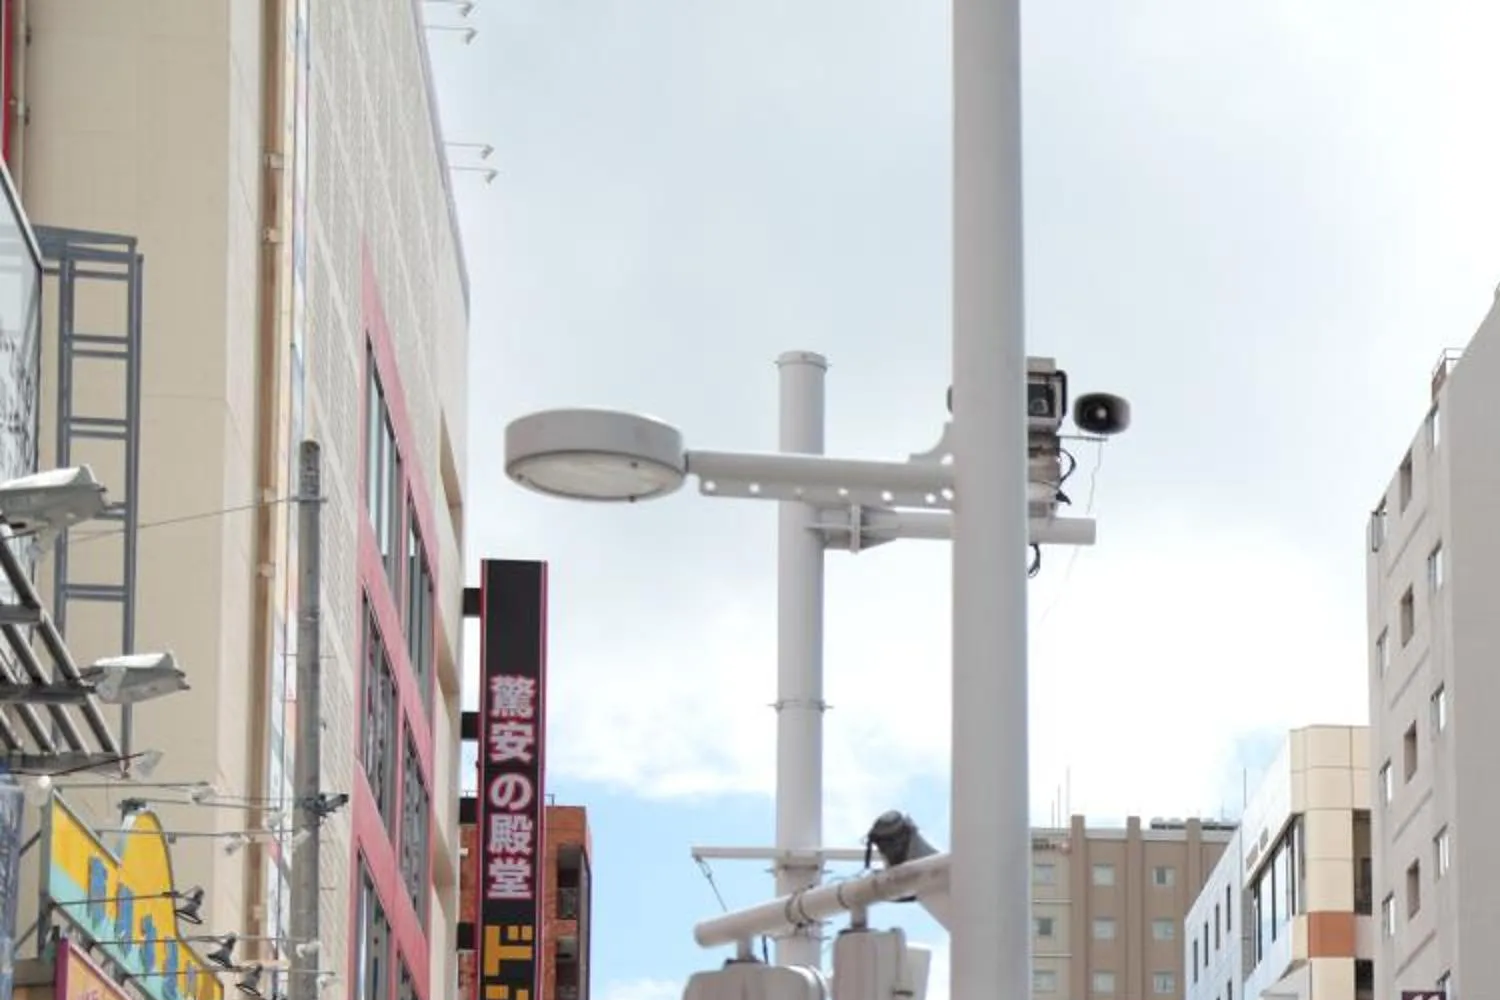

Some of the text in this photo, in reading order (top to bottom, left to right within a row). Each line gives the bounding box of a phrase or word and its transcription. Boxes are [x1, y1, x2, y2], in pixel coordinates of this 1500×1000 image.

[487, 674, 537, 898] 驚安の殿堂
